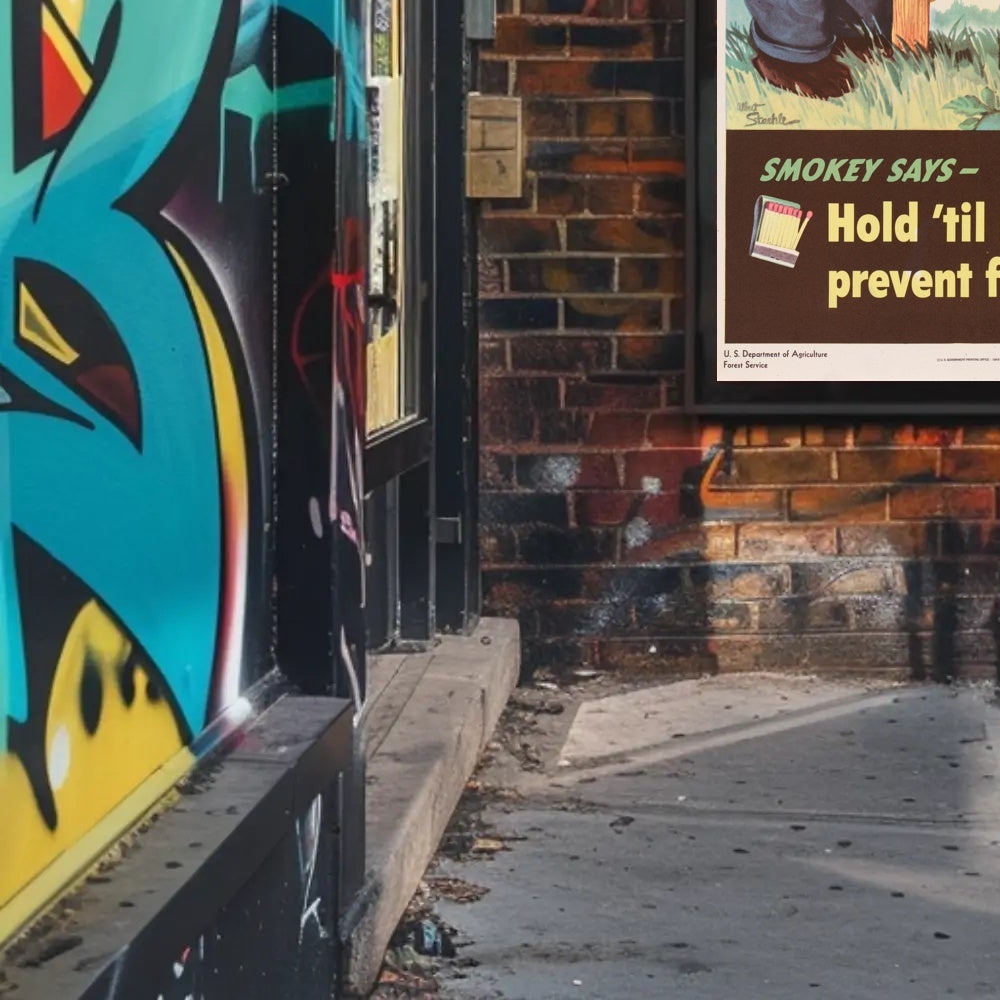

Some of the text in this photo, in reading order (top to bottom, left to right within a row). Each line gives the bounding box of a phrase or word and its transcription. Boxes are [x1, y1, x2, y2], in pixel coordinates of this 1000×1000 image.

[759, 157, 884, 183] SMOKEY
[828, 200, 919, 243] Hold
[932, 200, 986, 243] 'til
[828, 263, 973, 309] prevent
[723, 360, 768, 369] Forest Service
[742, 349, 781, 360] Department
[782, 349, 790, 358] of
[791, 349, 828, 360] Agriculture
